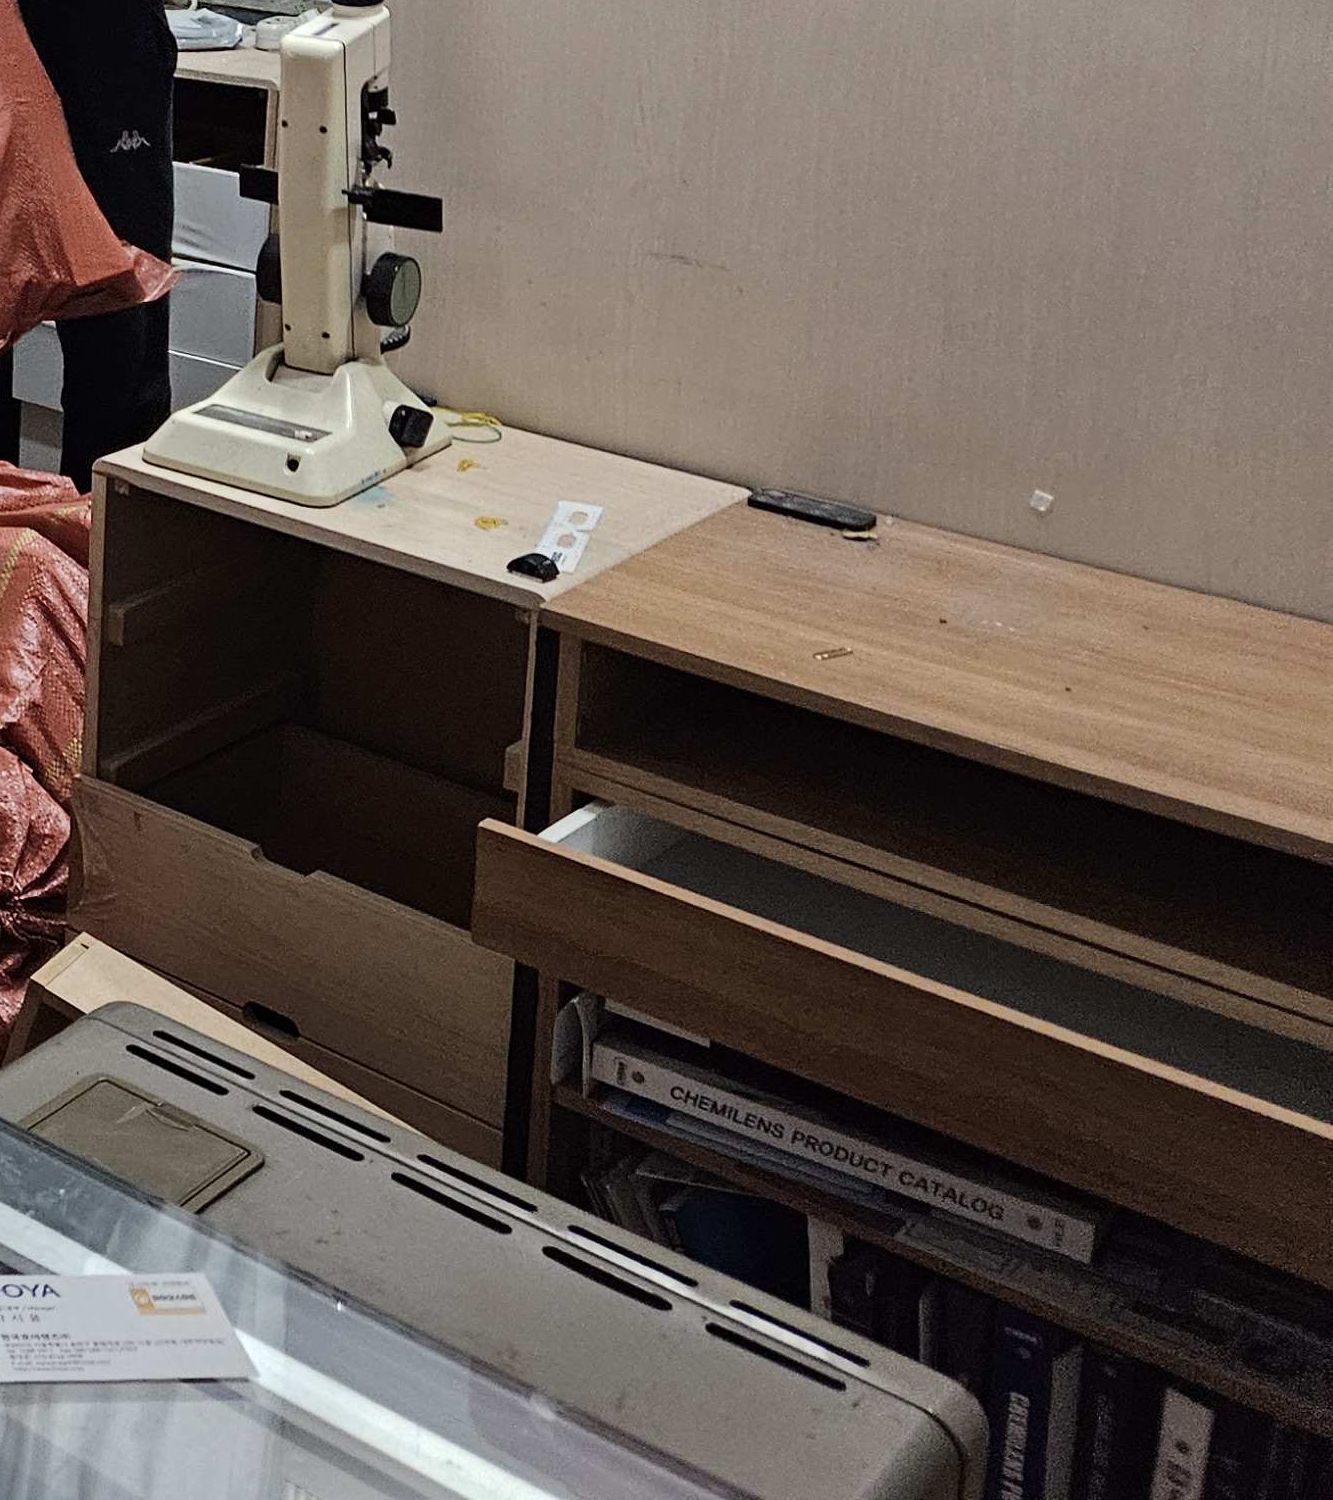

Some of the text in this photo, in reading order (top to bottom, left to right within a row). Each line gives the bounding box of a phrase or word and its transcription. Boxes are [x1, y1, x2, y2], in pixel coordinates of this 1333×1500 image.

[670, 1086, 1005, 1221] CHEMILENS PRODUCT CATALOG
